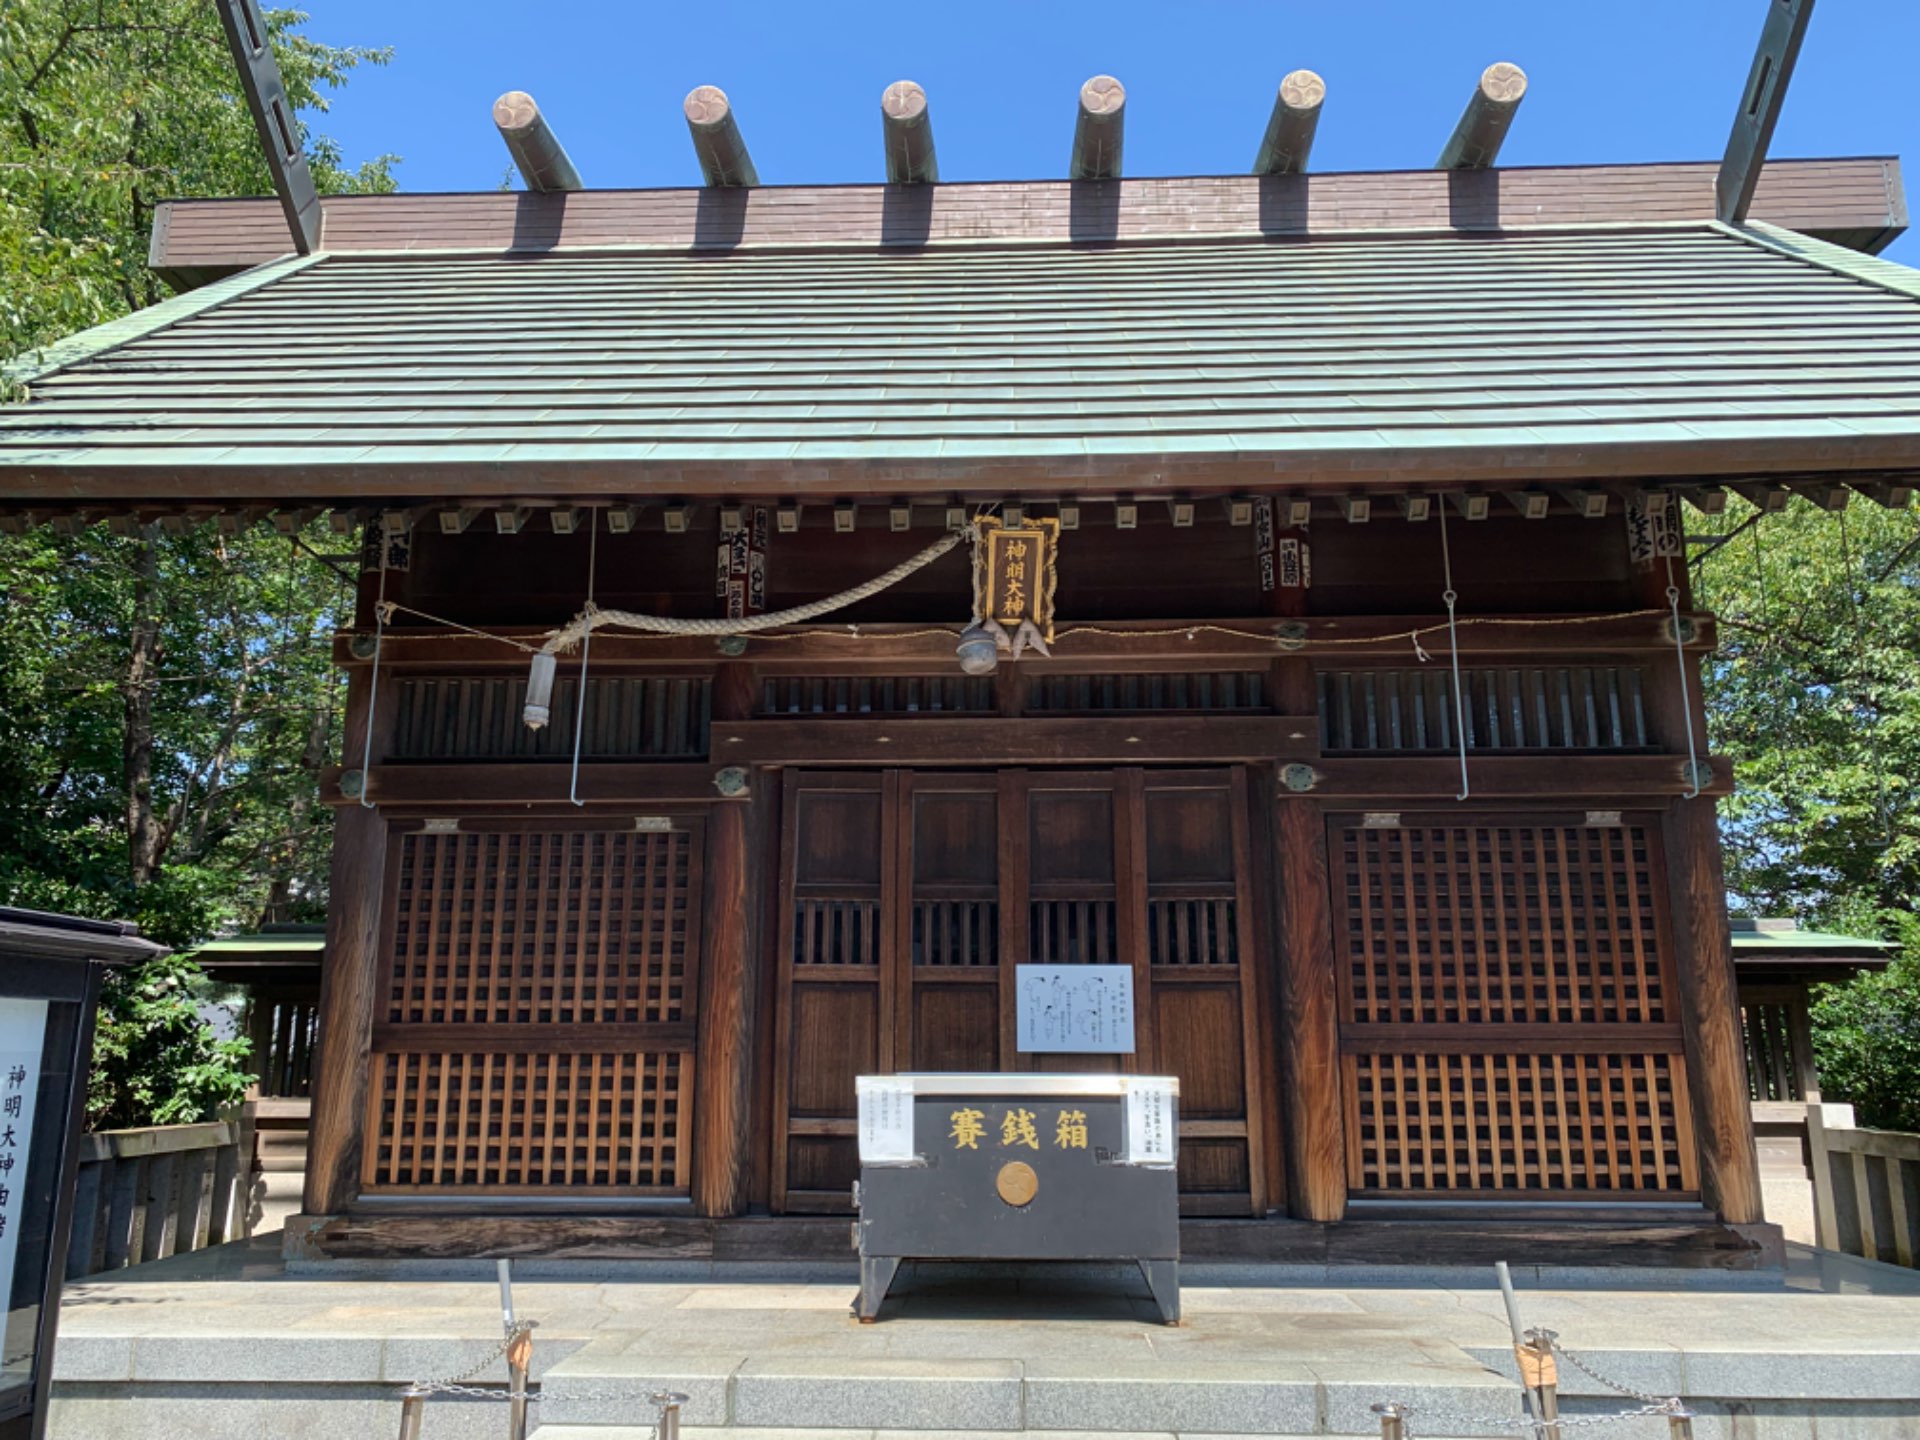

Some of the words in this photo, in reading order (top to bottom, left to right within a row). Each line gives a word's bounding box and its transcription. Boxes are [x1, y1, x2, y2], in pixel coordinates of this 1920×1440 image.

[1003, 540, 1027, 616] 神明大神
[949, 1107, 1088, 1150] 賽銭箱
